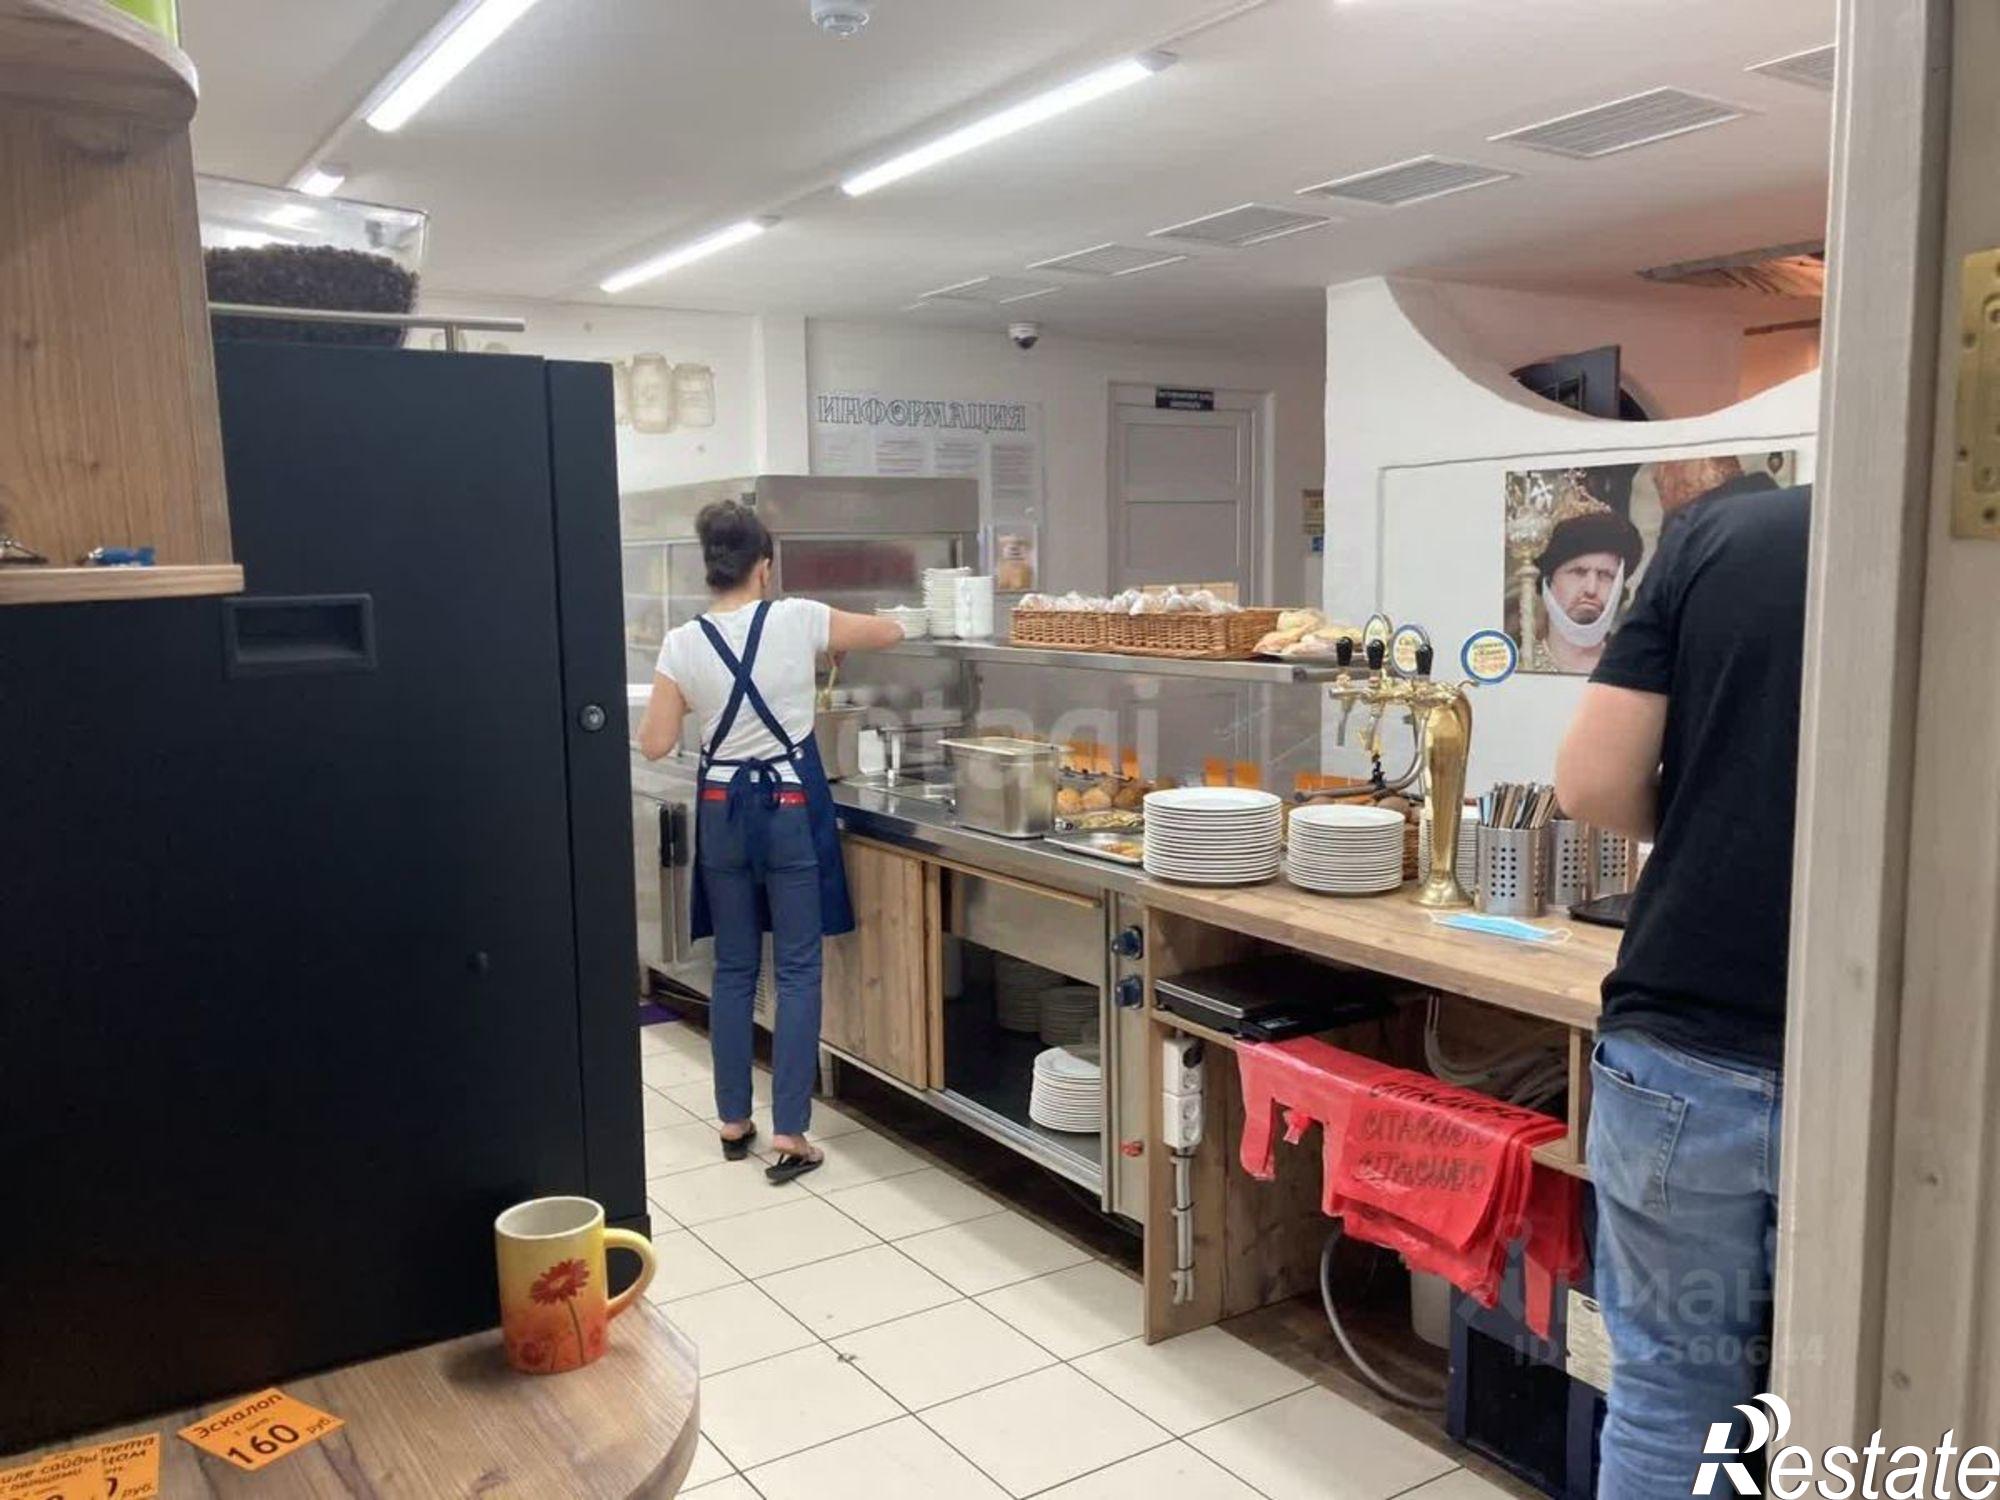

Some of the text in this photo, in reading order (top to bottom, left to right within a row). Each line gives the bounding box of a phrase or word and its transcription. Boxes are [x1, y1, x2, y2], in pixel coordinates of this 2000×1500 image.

[817, 394, 1027, 434] ИНФОРМАЦИЯ
[193, 1394, 283, 1439] Эскалоп
[227, 1424, 299, 1464] 160
